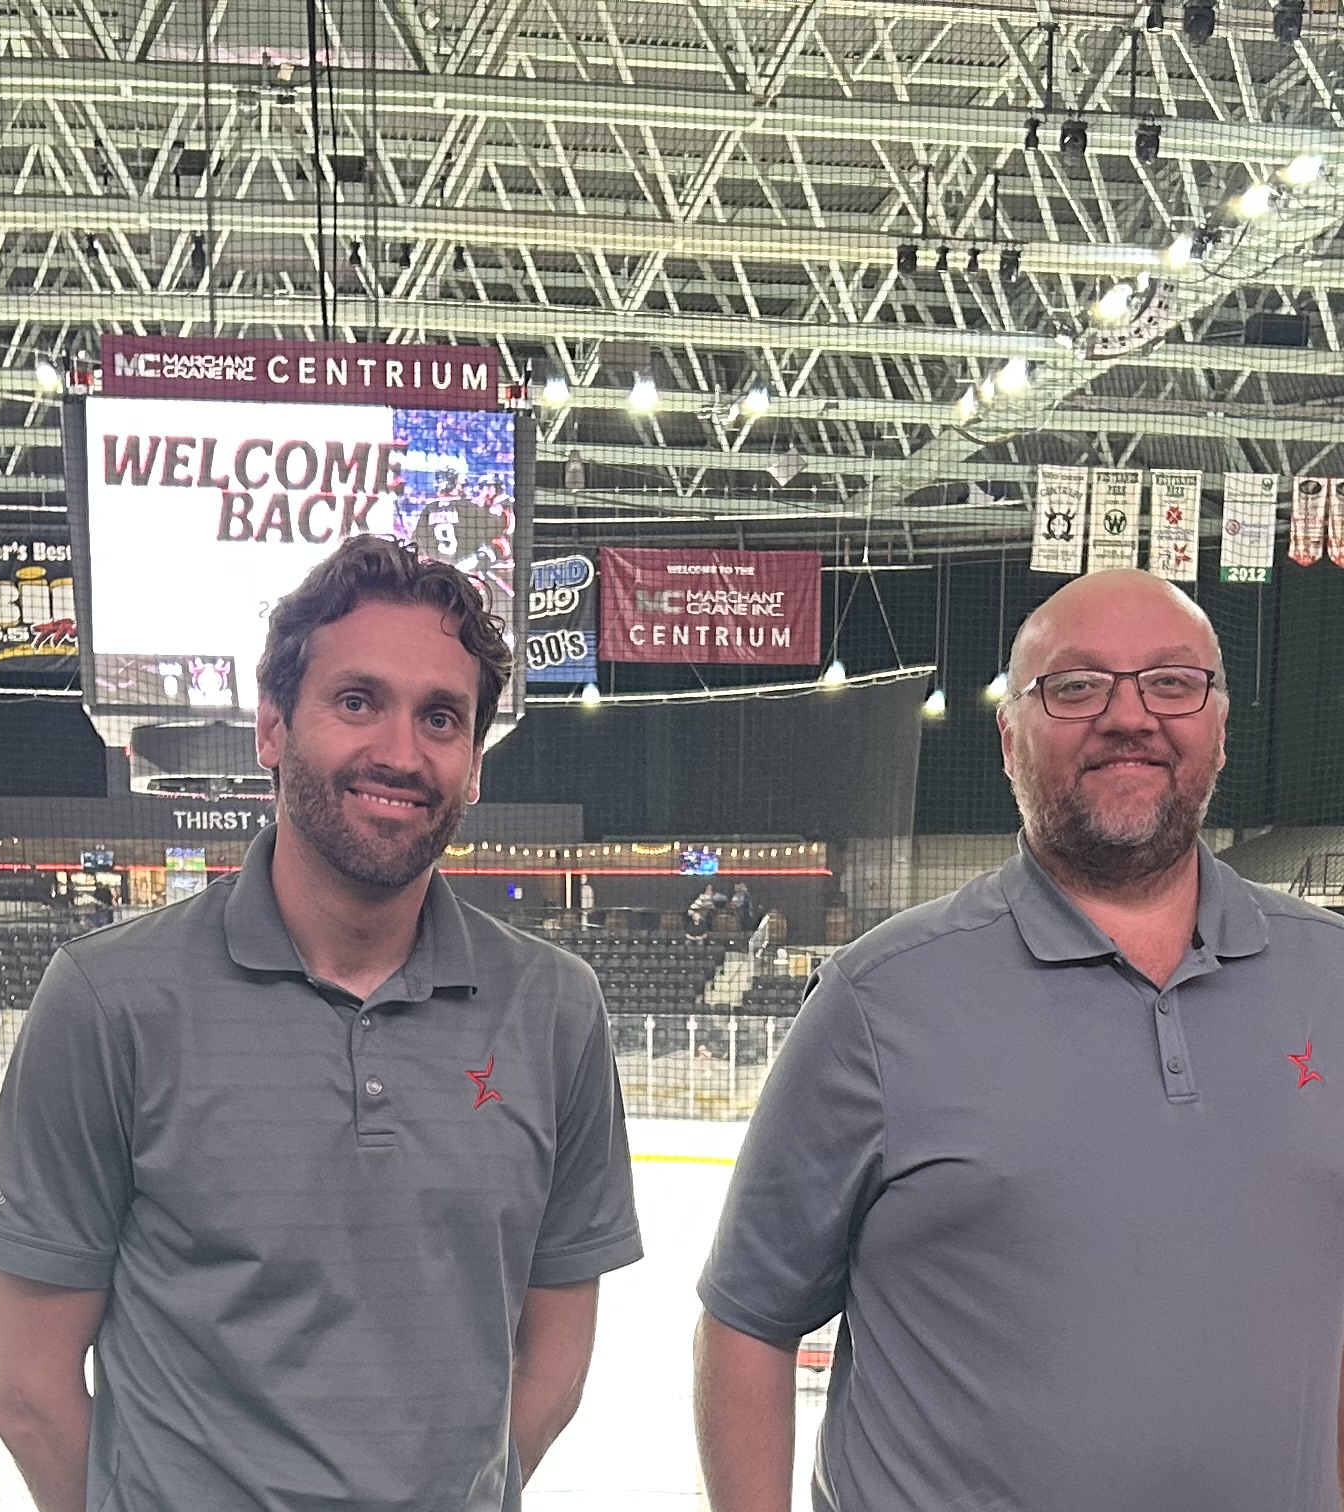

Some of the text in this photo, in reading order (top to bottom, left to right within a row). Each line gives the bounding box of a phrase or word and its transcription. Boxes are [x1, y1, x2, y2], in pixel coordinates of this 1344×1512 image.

[162, 353, 256, 369] MARCHANT
[162, 365, 223, 379] CRANE
[267, 355, 488, 391] CENTRIUM
[102, 434, 409, 495] WELCOME
[216, 489, 382, 544] BACK
[1227, 567, 1266, 582] 2012
[686, 589, 785, 604] MARCHANT
[686, 602, 748, 616] CRANE
[629, 624, 791, 648] CENTRIUM
[528, 632, 586, 668] 90's
[173, 811, 252, 830] THIRST
